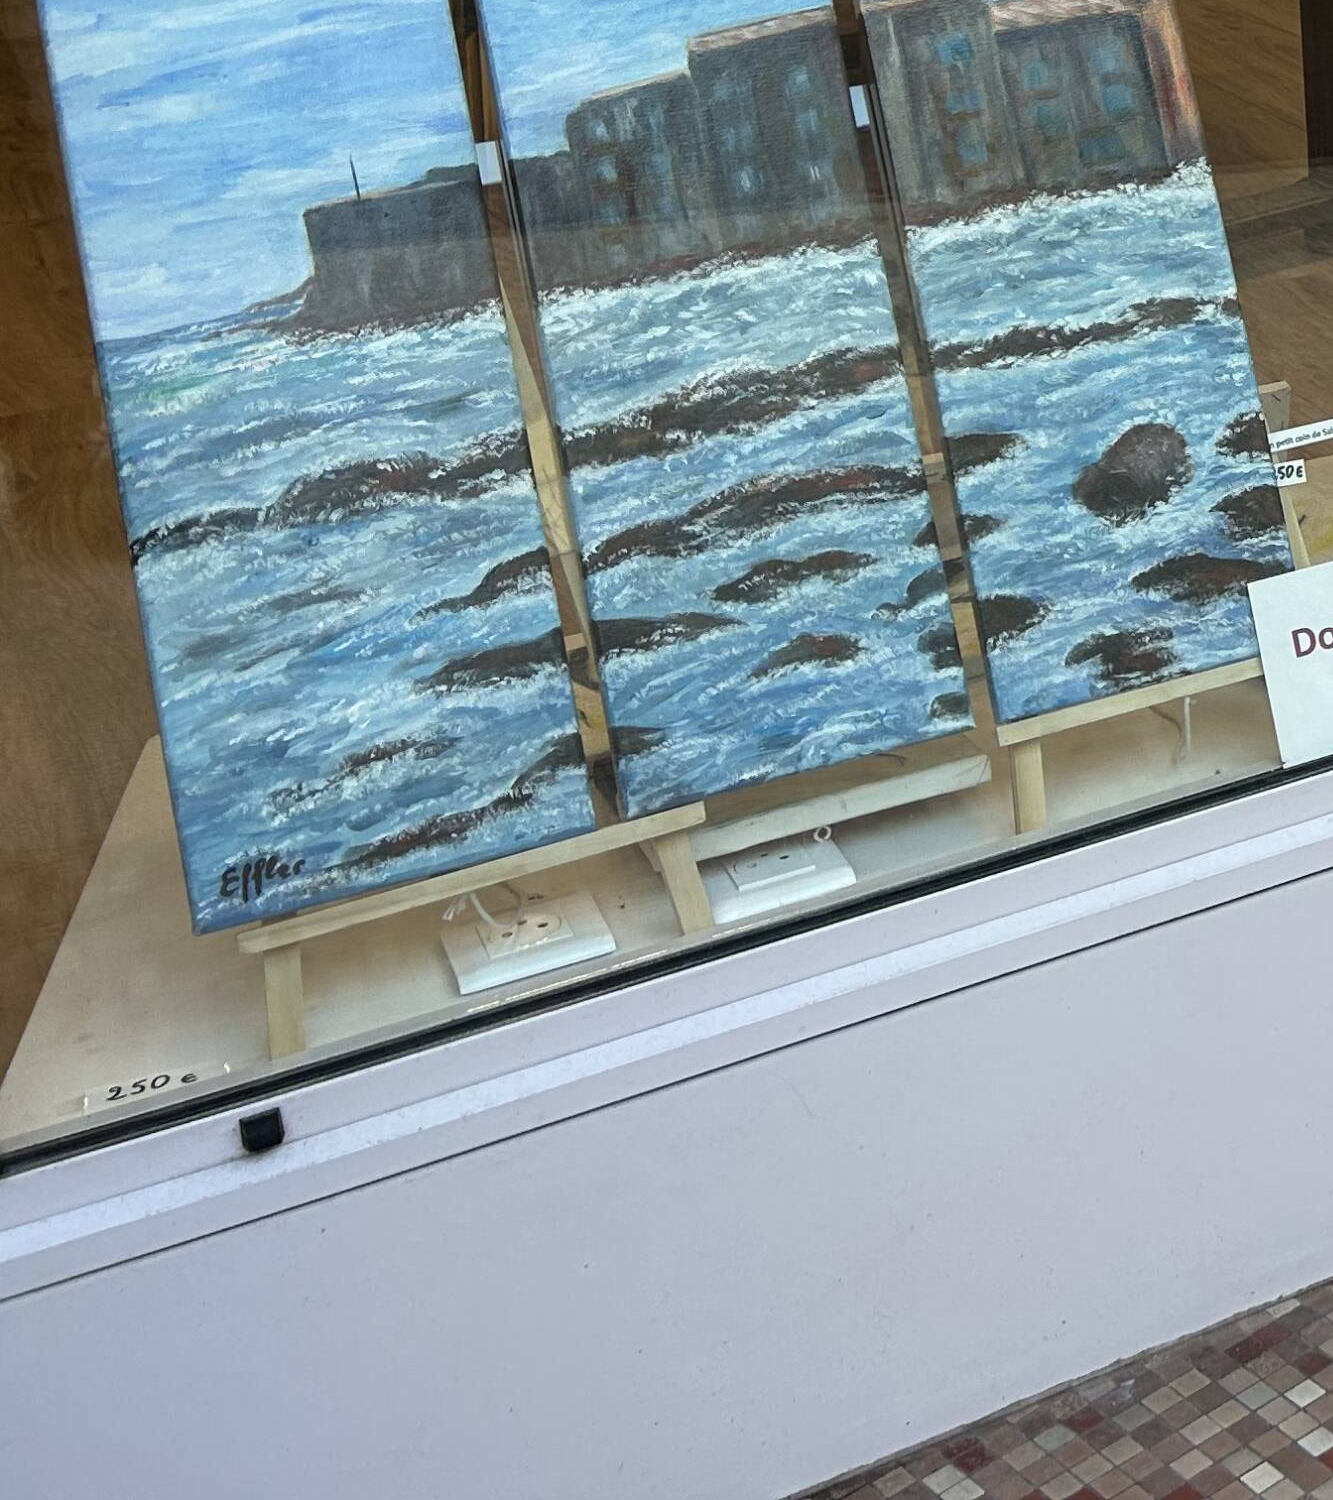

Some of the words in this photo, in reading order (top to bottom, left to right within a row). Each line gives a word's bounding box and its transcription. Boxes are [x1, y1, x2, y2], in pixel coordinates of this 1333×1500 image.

[1276, 436, 1295, 449] petit
[1294, 433, 1311, 443] coin
[1312, 430, 1322, 440] de
[219, 854, 307, 904] Effler
[106, 1073, 171, 1102] 250
[180, 1072, 199, 1084] €
